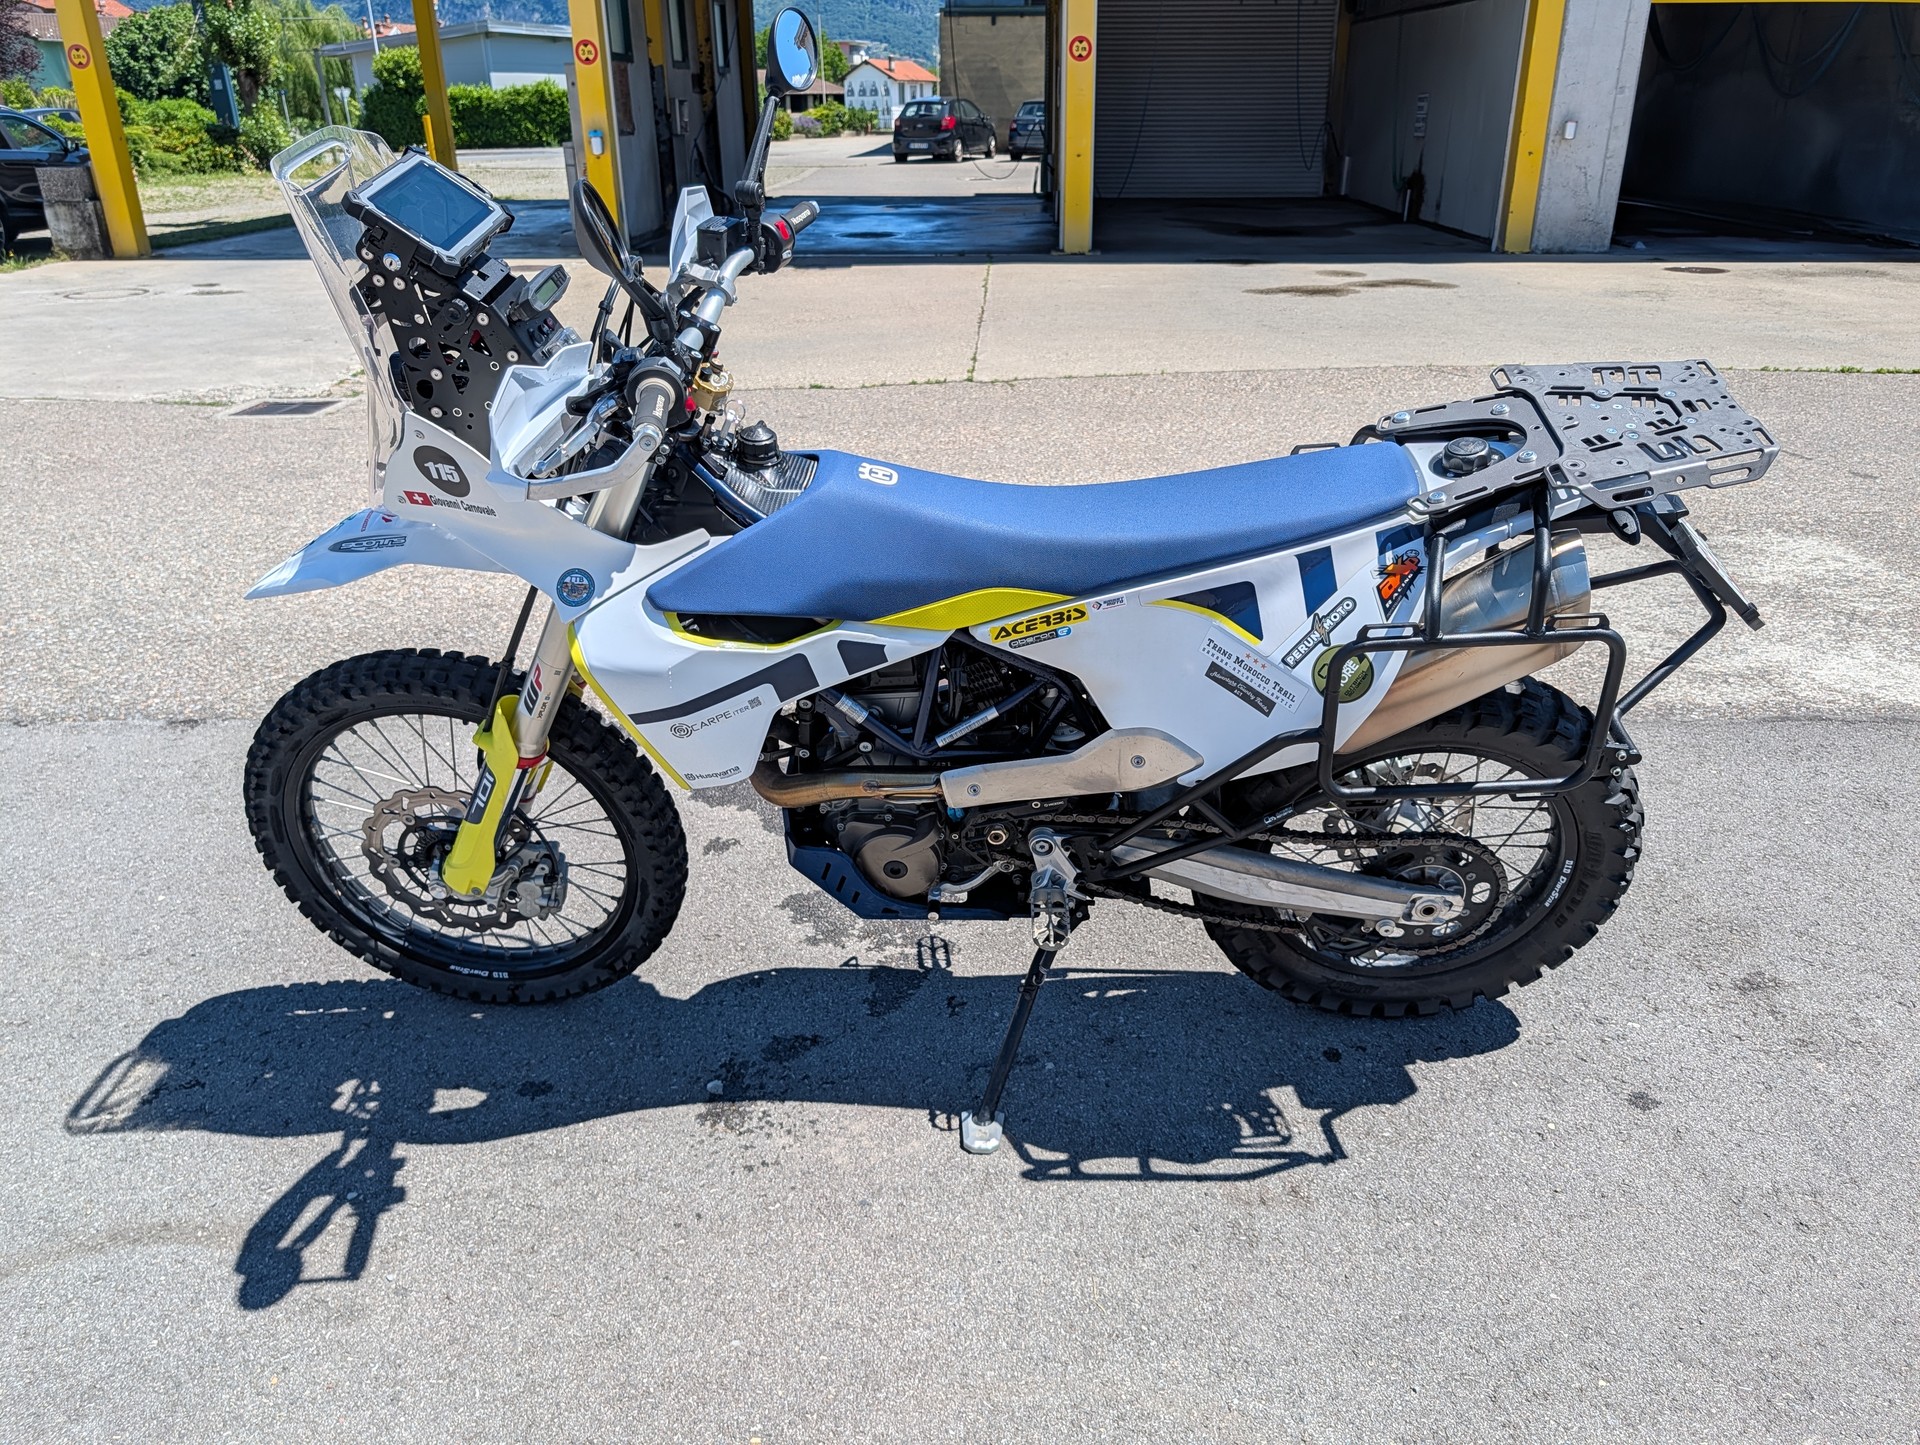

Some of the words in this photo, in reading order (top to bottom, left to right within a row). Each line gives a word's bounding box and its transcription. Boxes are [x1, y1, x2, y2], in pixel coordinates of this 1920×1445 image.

[424, 461, 461, 483] 115
[429, 494, 461, 511] Giovanni
[460, 500, 497, 517] Carnovale
[1385, 573, 1414, 609] RACING
[1287, 630, 1322, 666] PERUN
[1323, 600, 1353, 630] MOTO
[1340, 660, 1360, 687] ORE
[523, 662, 544, 717] WP
[690, 710, 733, 732] CARPE
[732, 705, 751, 717] ITER
[695, 765, 741, 779] Husqvarna
[471, 771, 495, 814] 701
